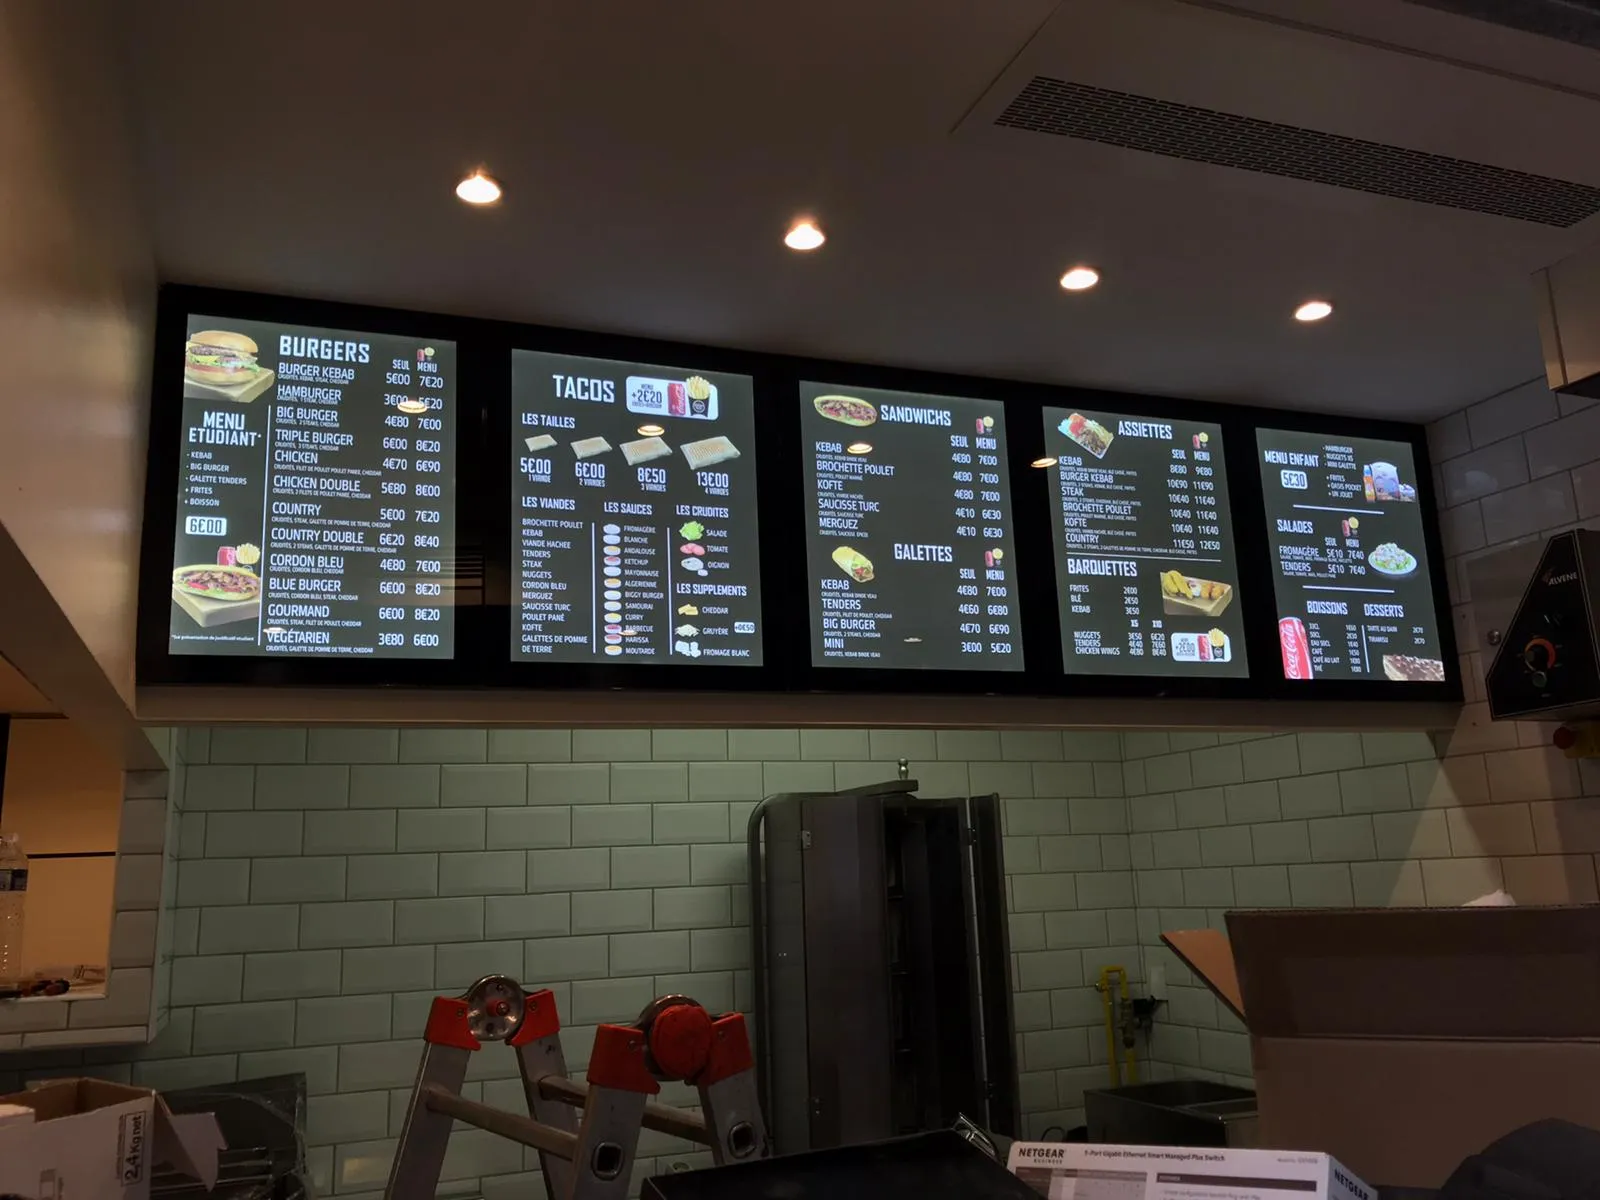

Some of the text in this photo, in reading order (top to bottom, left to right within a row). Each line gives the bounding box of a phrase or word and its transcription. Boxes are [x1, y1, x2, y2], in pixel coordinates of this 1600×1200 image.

[280, 335, 369, 363] BURGERS
[279, 362, 320, 378] BURGER
[323, 367, 355, 380] KEBAB
[392, 359, 437, 372] SEUL MENU
[386, 373, 443, 388] 5€00 7€20
[277, 385, 342, 400] HAMBURGER
[553, 375, 614, 403] TACOS
[277, 406, 338, 421] BIG BURGER
[880, 405, 951, 426] SANDWICHS
[203, 411, 245, 430] MENU
[385, 416, 441, 430] 4€80 7€00
[522, 413, 575, 429] LES TAILLES
[1118, 420, 1172, 439] ASSIETTES
[275, 429, 309, 442] TRIPLE
[312, 434, 353, 446] BURGER
[951, 435, 996, 449] SEUL MENU
[383, 437, 440, 452] 6€00 8€20
[816, 441, 842, 453] KEBAB
[275, 450, 318, 464] CHICKEN
[1059, 456, 1082, 466] KEBAB
[1265, 451, 1319, 467] MENU ENFANT
[203, 464, 229, 472] BURGER
[383, 458, 407, 470] 4€70
[416, 460, 440, 472] 6€90
[816, 461, 894, 476] BROCHETTE POULET
[521, 457, 728, 487] 5€00 6€00 8€50 13€00
[1061, 472, 1113, 483] BURGER KEBAB
[190, 475, 247, 485] GALETTE TENDERS
[274, 475, 360, 492] CHICKEN DOUBLE
[818, 480, 843, 490] KOFTE
[381, 482, 406, 494] 5€80
[415, 485, 440, 497] 8€00
[1062, 487, 1084, 496] STEAK
[190, 498, 219, 506] BOISSON
[523, 496, 575, 510] LES VIANDES
[604, 502, 652, 515] LES SAUCES
[818, 499, 880, 512] SAUCISSE TURC
[1063, 502, 1131, 515] BROCHETTE POULET
[272, 502, 321, 516] COUNTRY
[676, 505, 728, 518] LES CRUDITES
[190, 519, 222, 533] 6€00
[522, 518, 583, 529] BROCHETTE POULET
[819, 518, 858, 529] MERGUEZ
[1065, 518, 1087, 527] KOFTE
[1277, 519, 1313, 534] SALADES
[271, 528, 364, 543] COUNTRY DOUBLE
[523, 529, 543, 537] KEBAB
[1066, 533, 1099, 544] COUNTRY
[523, 550, 551, 558] TENDERS
[894, 543, 952, 562] GALETTES
[270, 554, 344, 568] CORDON BLEU
[522, 560, 542, 568] STEAK
[1068, 558, 1137, 576] BARQUETTES
[1280, 561, 1311, 571] TENDERS
[523, 571, 552, 579] NUGGETS
[960, 568, 1004, 581] SEUL MENU
[270, 578, 341, 592] BLUE BURGER
[677, 583, 747, 596] LES SUPPLEMENTS
[821, 579, 849, 590] KEBAB
[1070, 585, 1089, 593] FRITES
[523, 592, 552, 600] MERGUEZ
[268, 604, 329, 617] GOURMAND
[522, 603, 552, 611] SAUCISSE
[823, 599, 861, 610] TENDERS
[1072, 605, 1090, 613] KEBAB
[1307, 600, 1347, 615] BOISSONS
[1364, 603, 1404, 617] DESSERTS
[823, 618, 875, 631] BIG BURGER
[522, 635, 553, 643] GALETTES
[564, 636, 588, 644] POMME
[824, 638, 844, 649] MINI
[1076, 647, 1120, 655] CHICKEN WINGS
[1019, 1148, 1064, 1158] NETGEAR
[1335, 1169, 1369, 1200] NETGEAR
